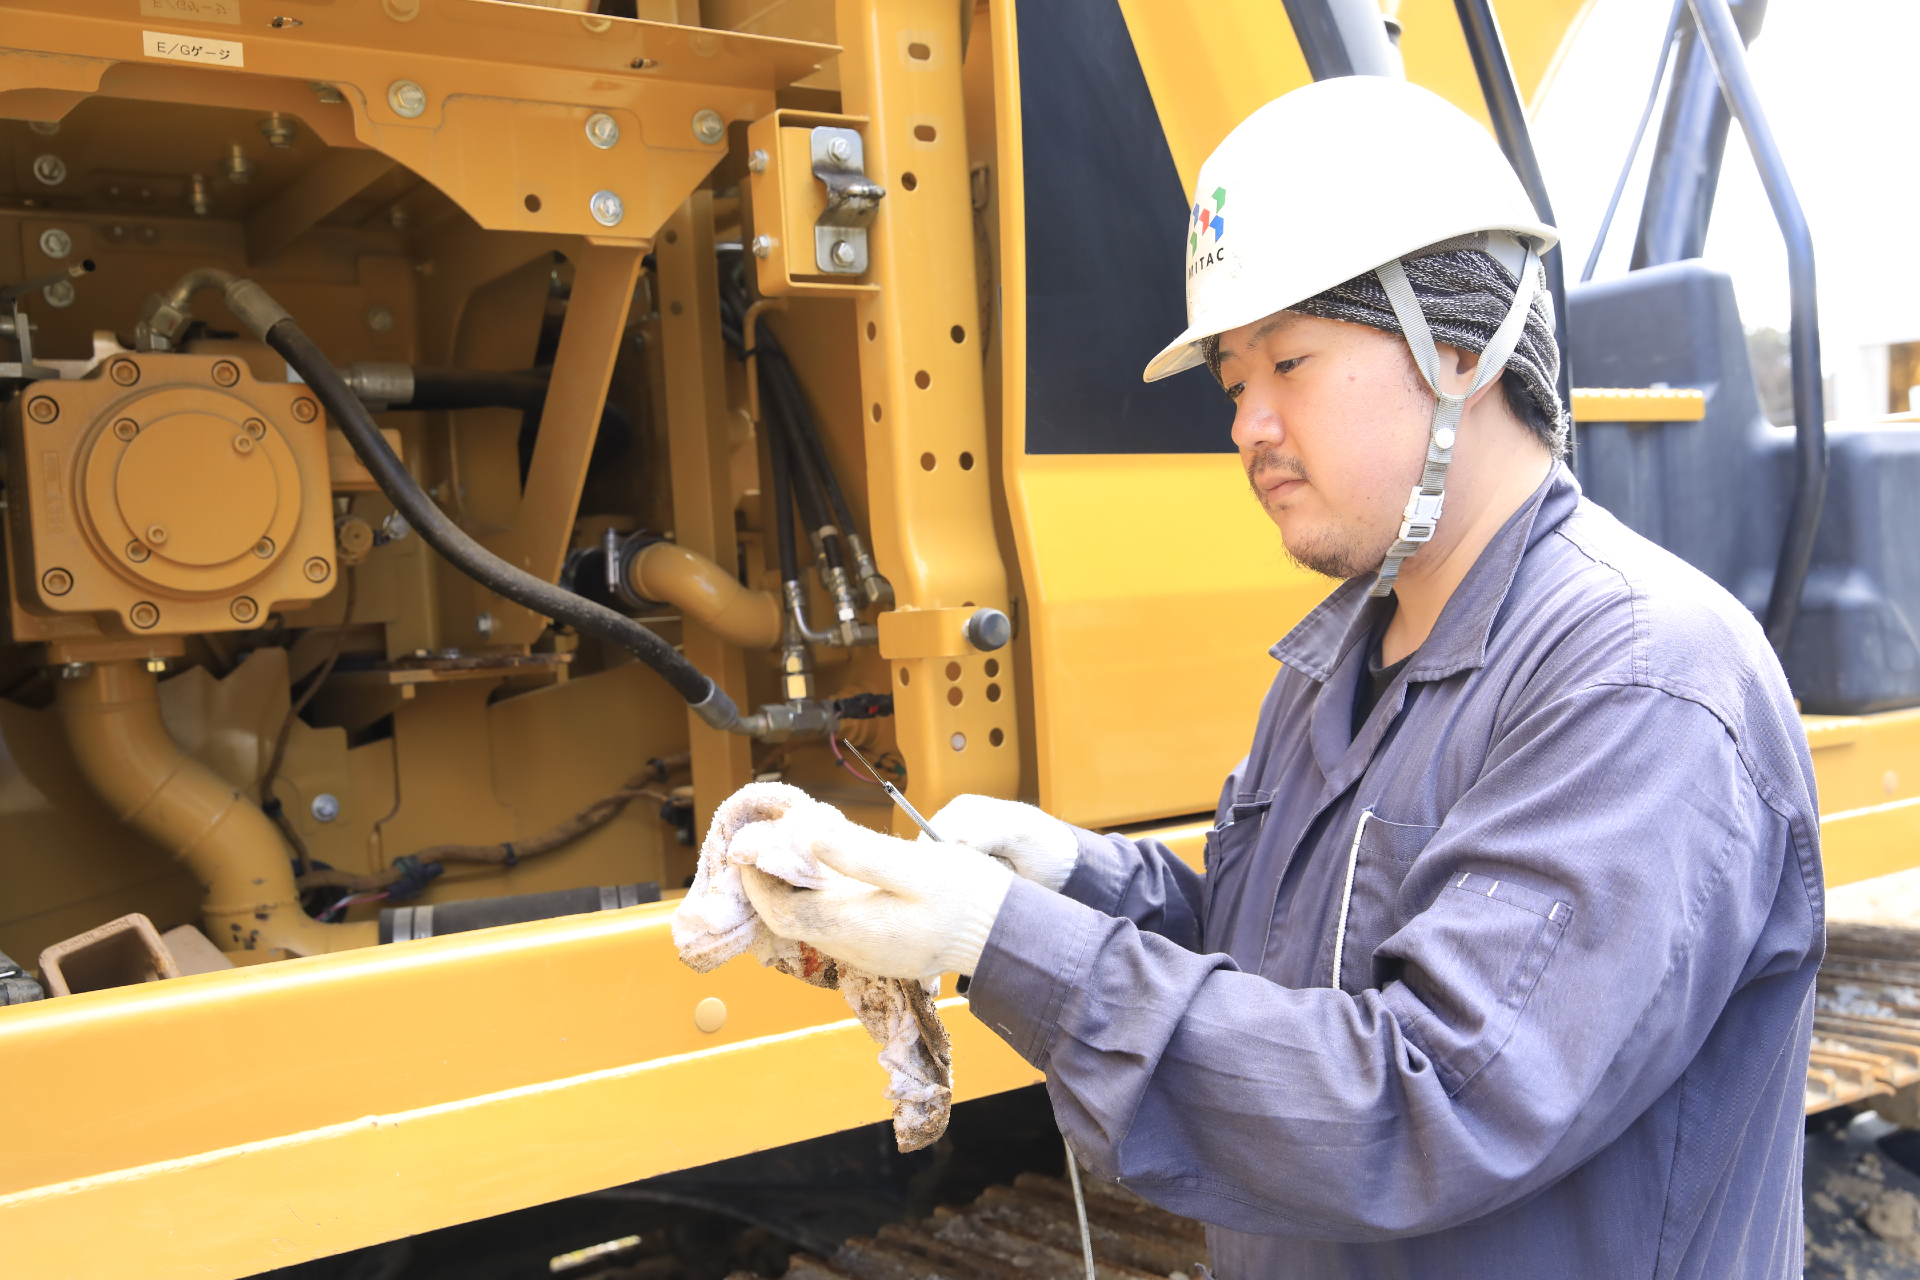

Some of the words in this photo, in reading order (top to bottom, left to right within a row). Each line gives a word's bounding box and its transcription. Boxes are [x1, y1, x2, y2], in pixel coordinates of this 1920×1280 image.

[157, 41, 231, 60] E/Gゲージ
[1188, 247, 1225, 280] MITAC
